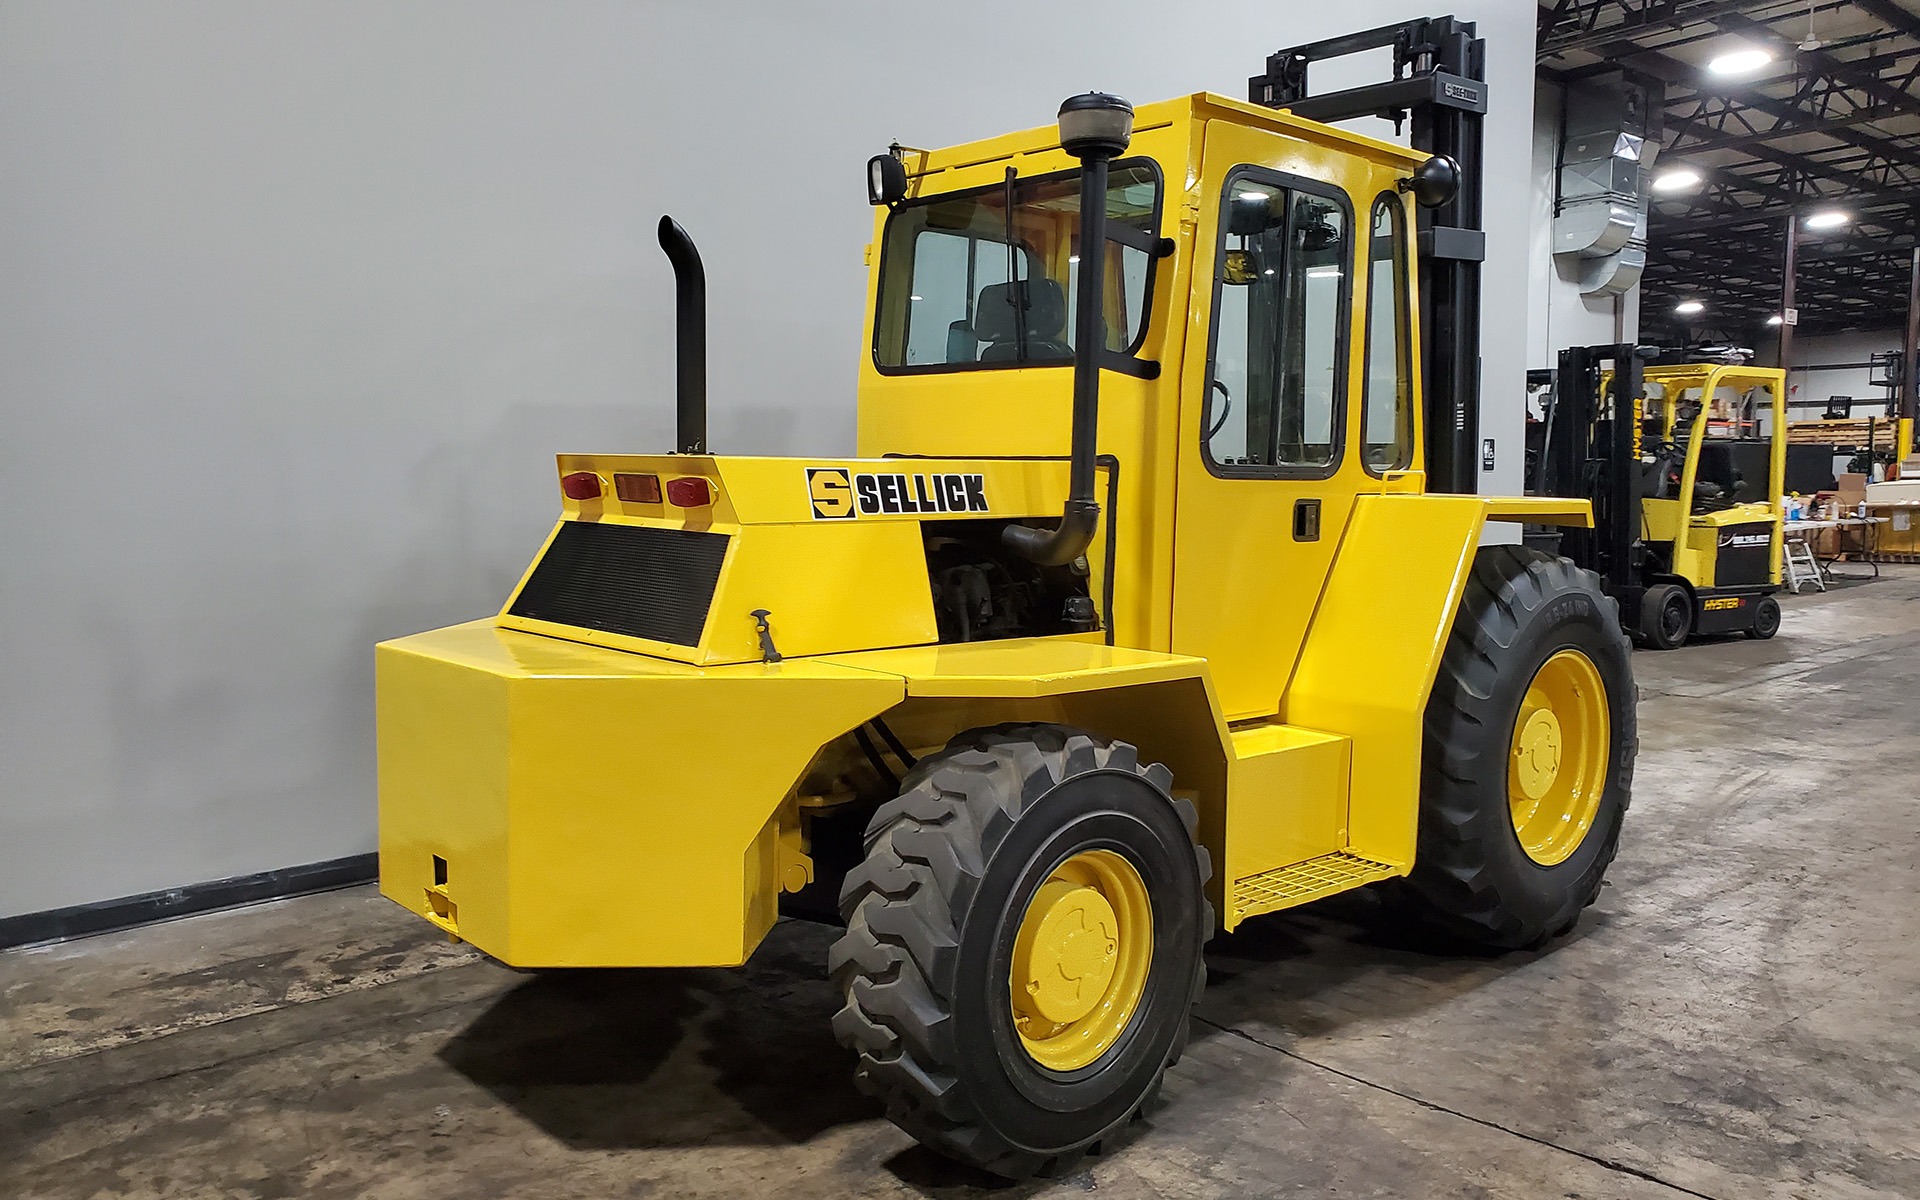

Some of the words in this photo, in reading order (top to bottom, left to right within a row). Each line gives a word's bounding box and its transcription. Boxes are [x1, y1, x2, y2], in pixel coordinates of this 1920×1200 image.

[808, 469, 854, 518] S
[856, 475, 989, 513] SELLICK
[1703, 597, 1739, 611] HYSTER
